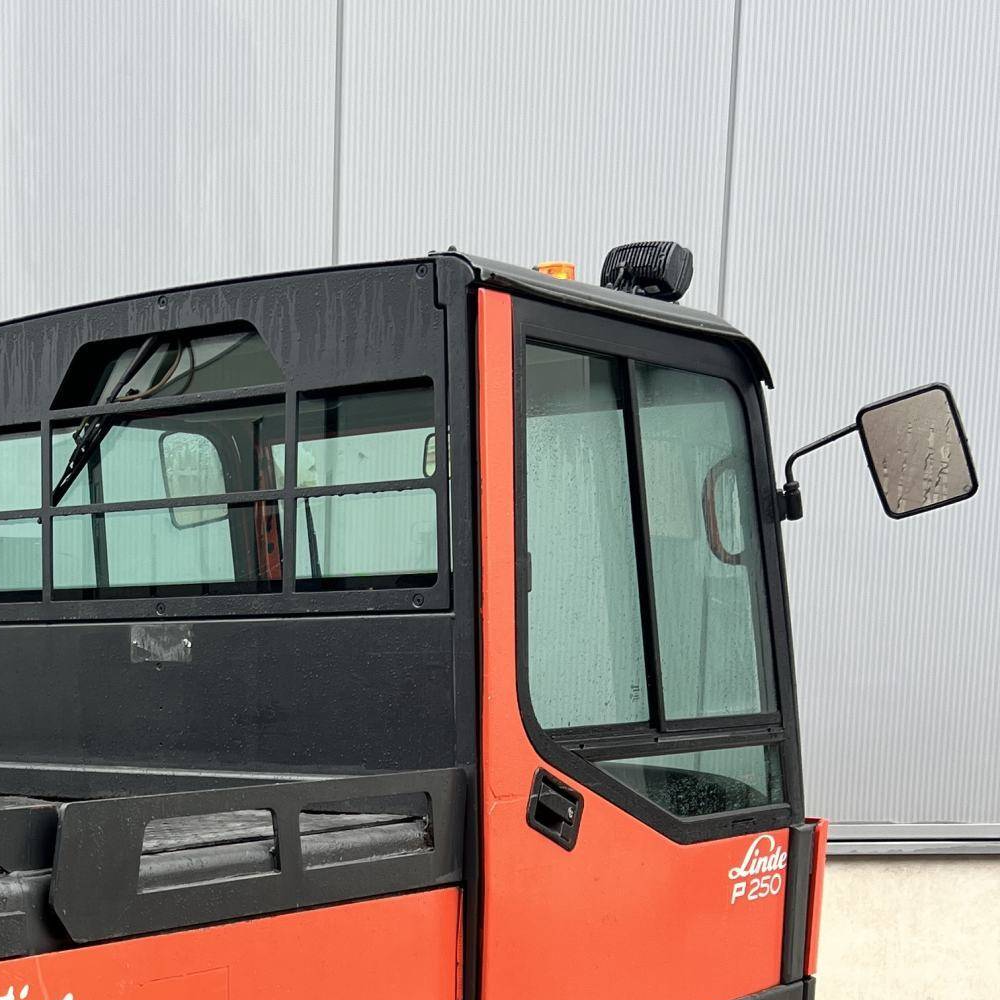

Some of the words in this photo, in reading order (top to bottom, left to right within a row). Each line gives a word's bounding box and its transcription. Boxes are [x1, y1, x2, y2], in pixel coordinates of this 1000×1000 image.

[728, 834, 787, 880] Linde
[731, 881, 747, 904] P
[747, 873, 782, 900] 250
